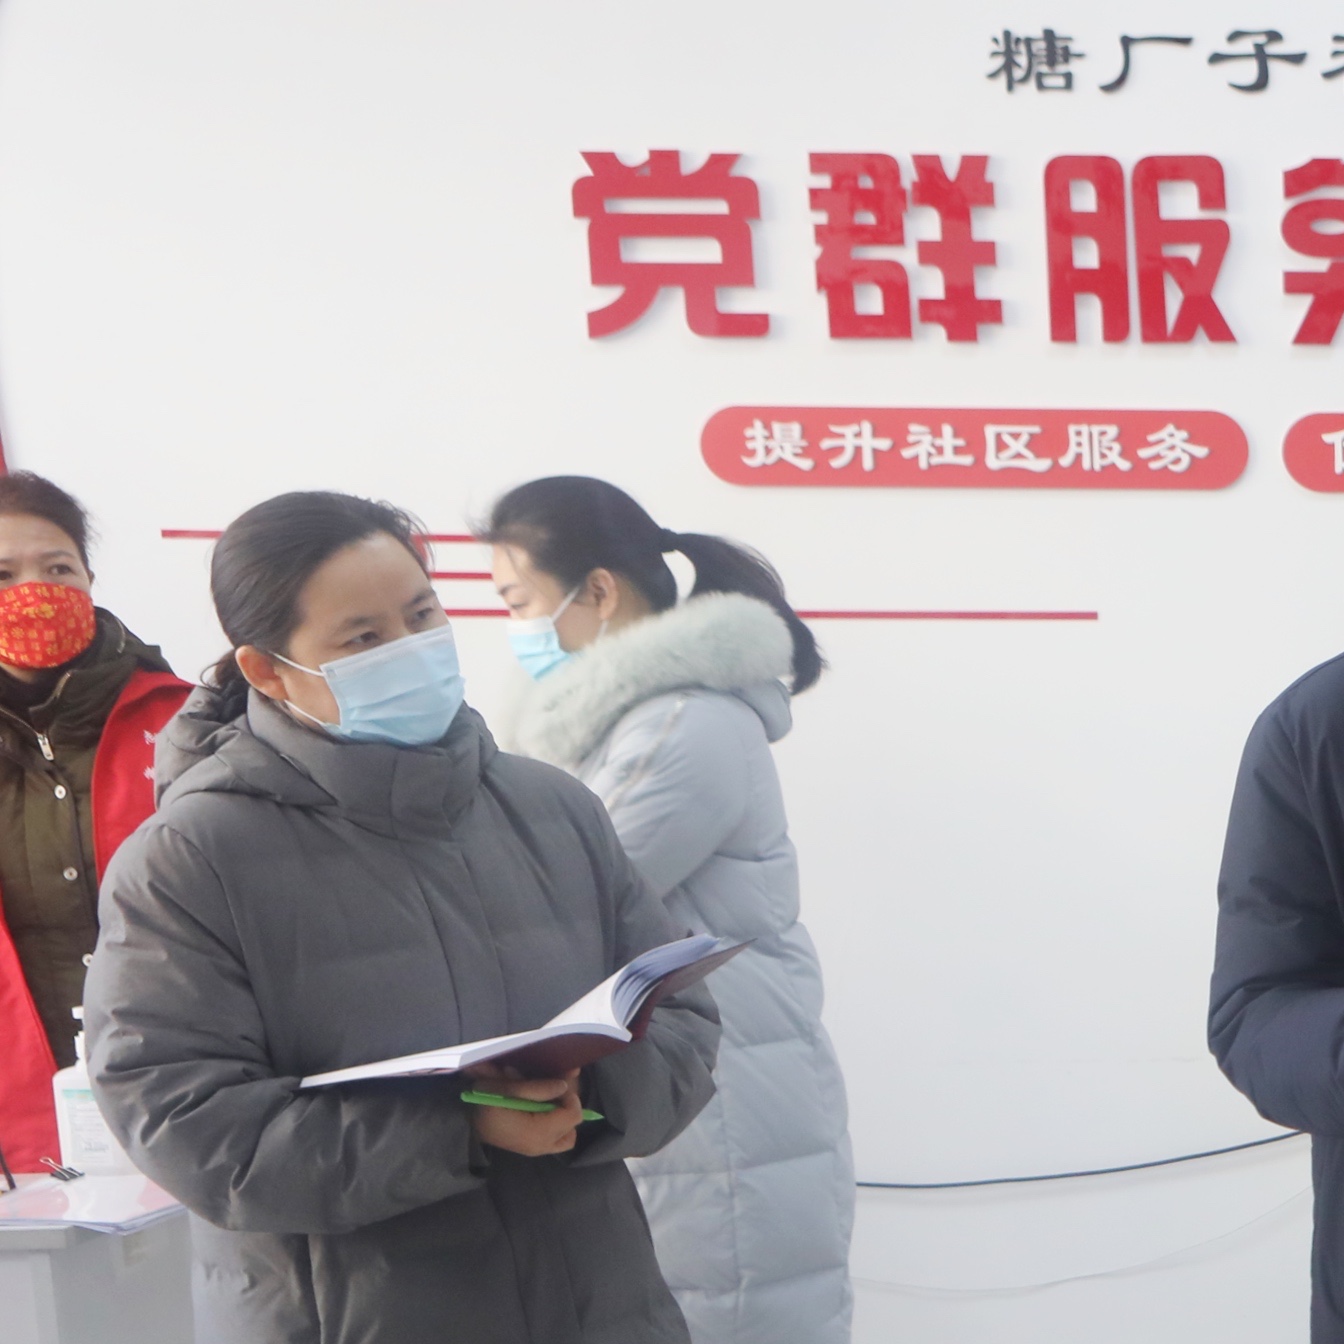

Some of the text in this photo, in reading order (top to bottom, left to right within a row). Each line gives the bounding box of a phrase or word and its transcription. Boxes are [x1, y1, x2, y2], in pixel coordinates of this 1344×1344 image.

[742, 419, 1209, 473] 提升社区服务
